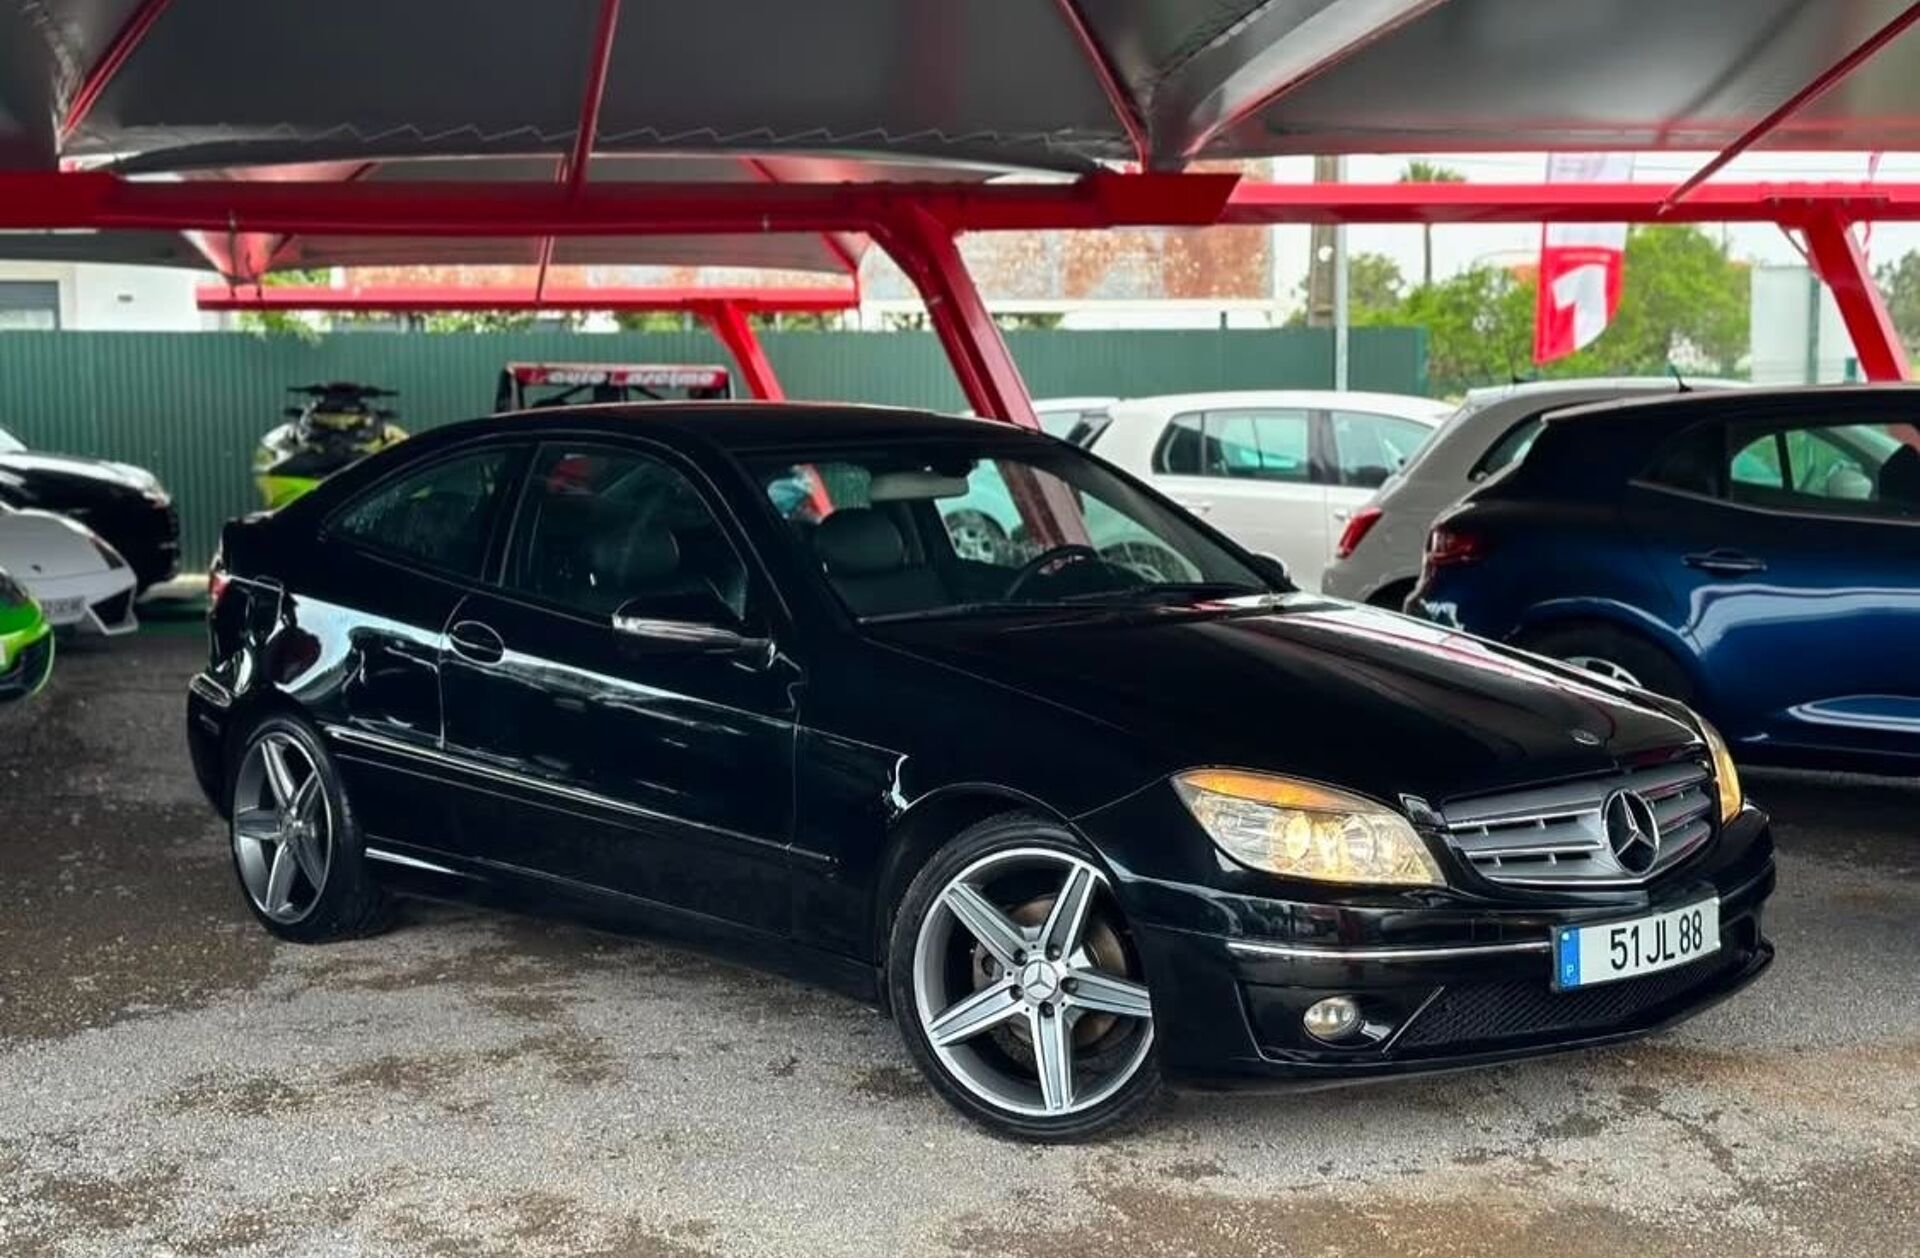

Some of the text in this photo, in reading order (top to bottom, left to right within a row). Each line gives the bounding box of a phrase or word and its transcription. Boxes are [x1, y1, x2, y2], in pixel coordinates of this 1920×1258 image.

[1610, 910, 1703, 970] 51 JL 88
[1566, 964, 1574, 977] P
